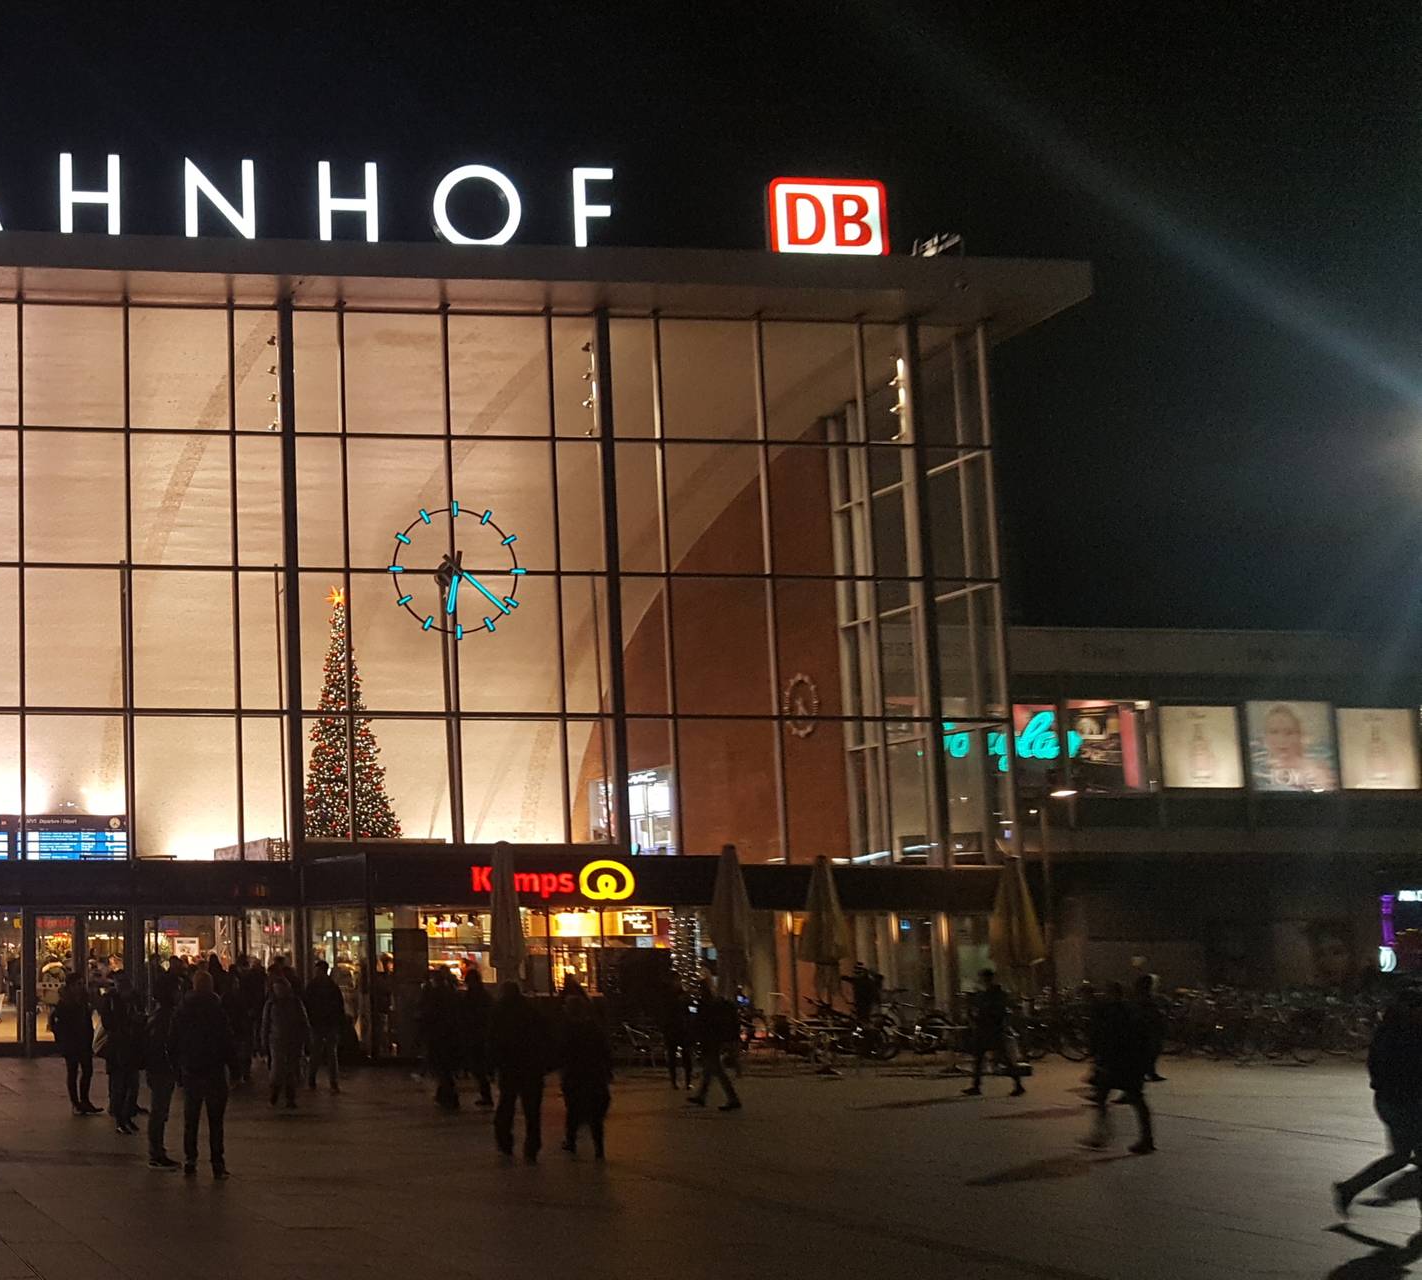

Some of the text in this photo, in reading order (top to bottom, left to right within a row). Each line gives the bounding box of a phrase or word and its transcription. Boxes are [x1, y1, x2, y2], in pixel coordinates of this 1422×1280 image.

[785, 192, 873, 247] DB
[942, 711, 1084, 772] oglas
[471, 866, 576, 899] Kmps
